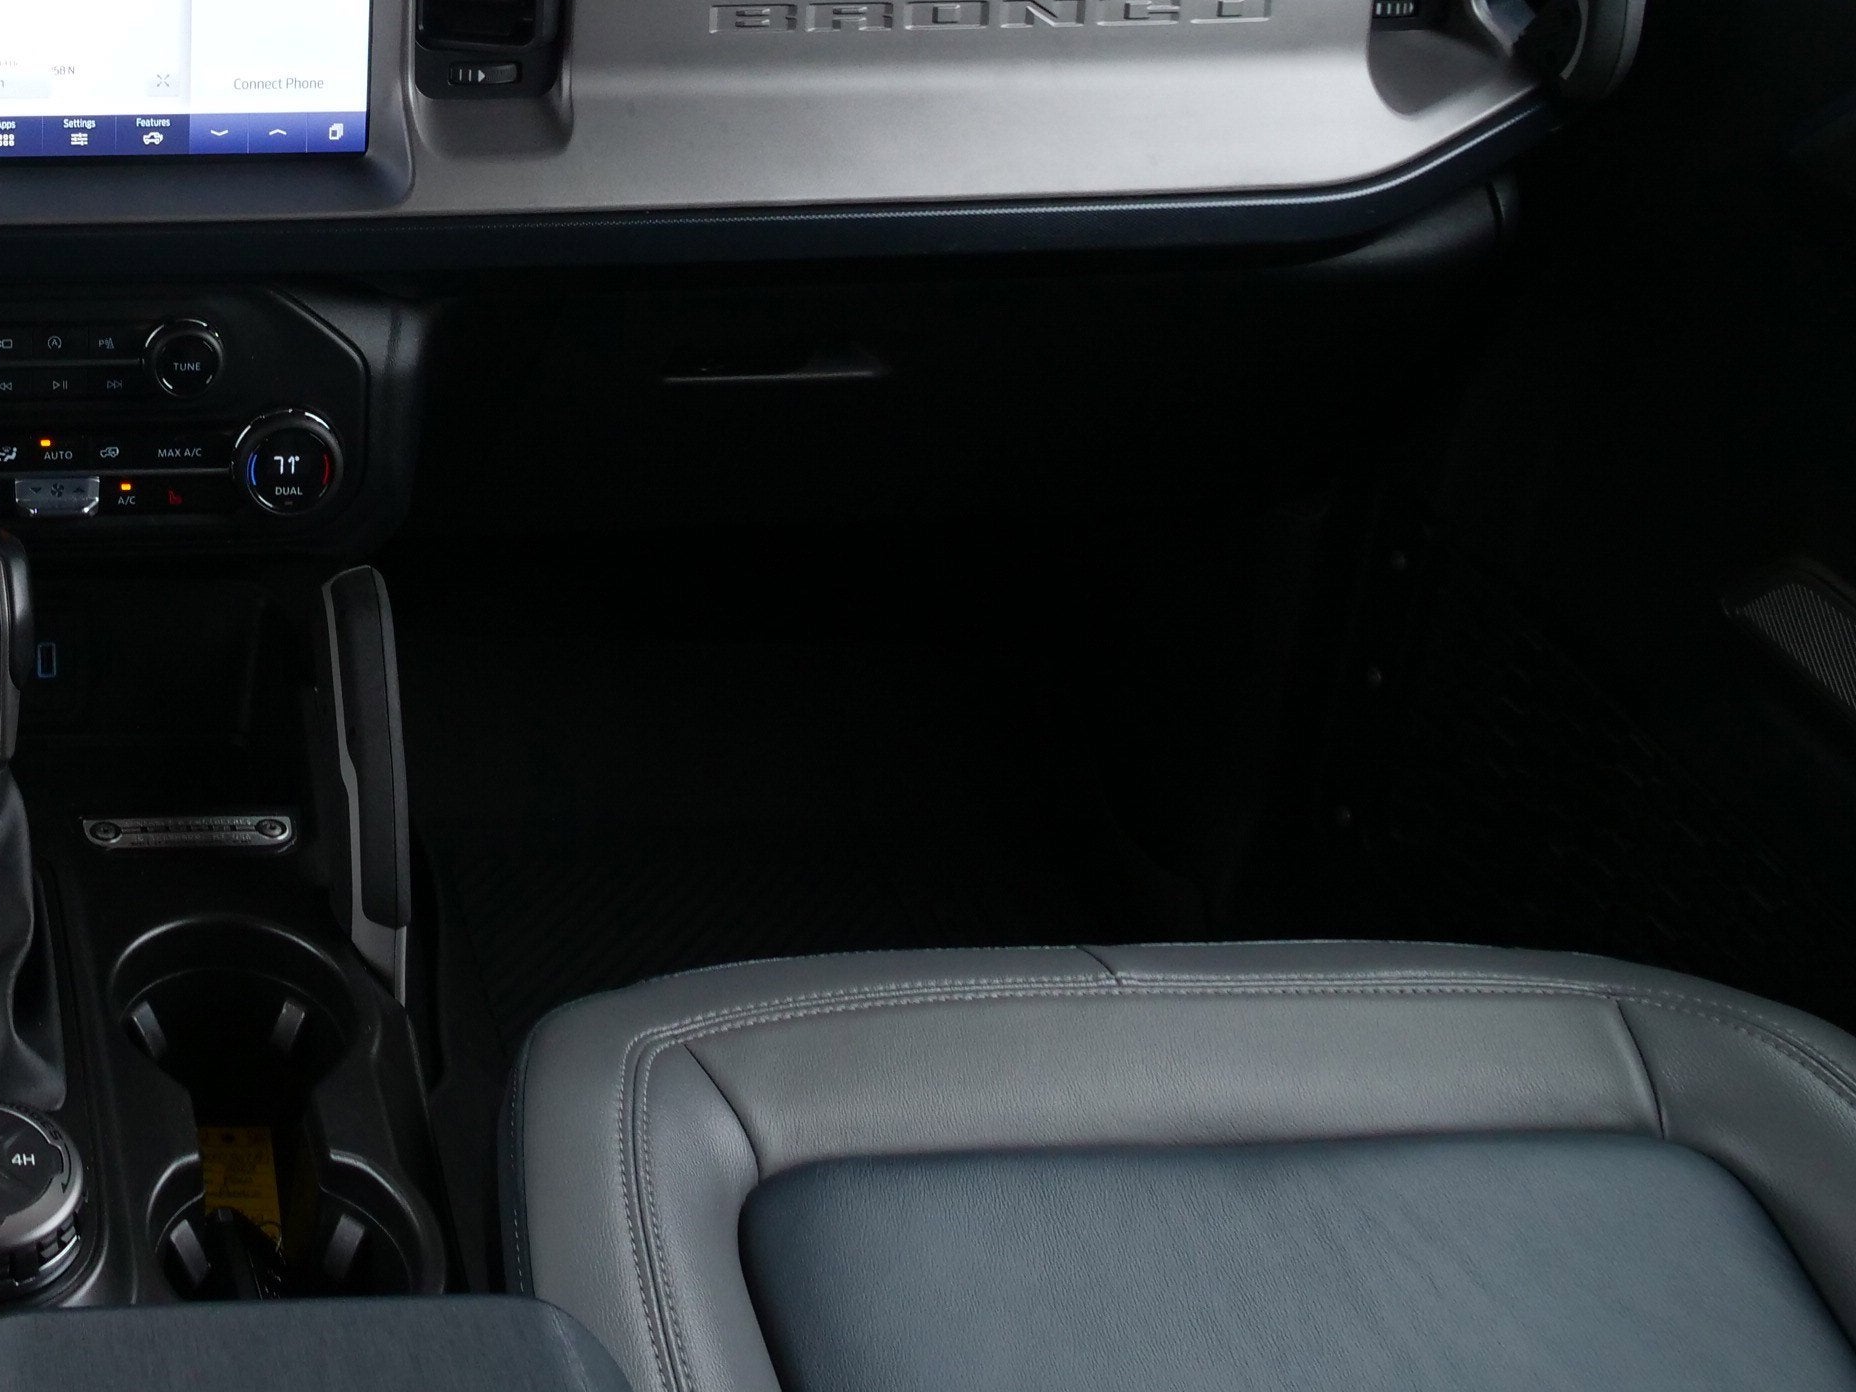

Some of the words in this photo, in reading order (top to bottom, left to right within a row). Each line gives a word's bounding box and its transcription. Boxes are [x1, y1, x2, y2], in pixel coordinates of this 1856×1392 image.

[50, 65, 66, 76] 58
[67, 65, 75, 75] N
[234, 78, 281, 90] Connect
[285, 77, 324, 90] Phone
[63, 118, 97, 131] Settings
[136, 117, 171, 128] Features
[173, 361, 201, 372] TUNE
[44, 450, 73, 460] AUTO
[157, 448, 181, 458] MAX
[183, 447, 202, 458] A/C
[274, 486, 303, 496] DUAL
[117, 495, 136, 506] A/C
[11, 1153, 36, 1166] 4H
